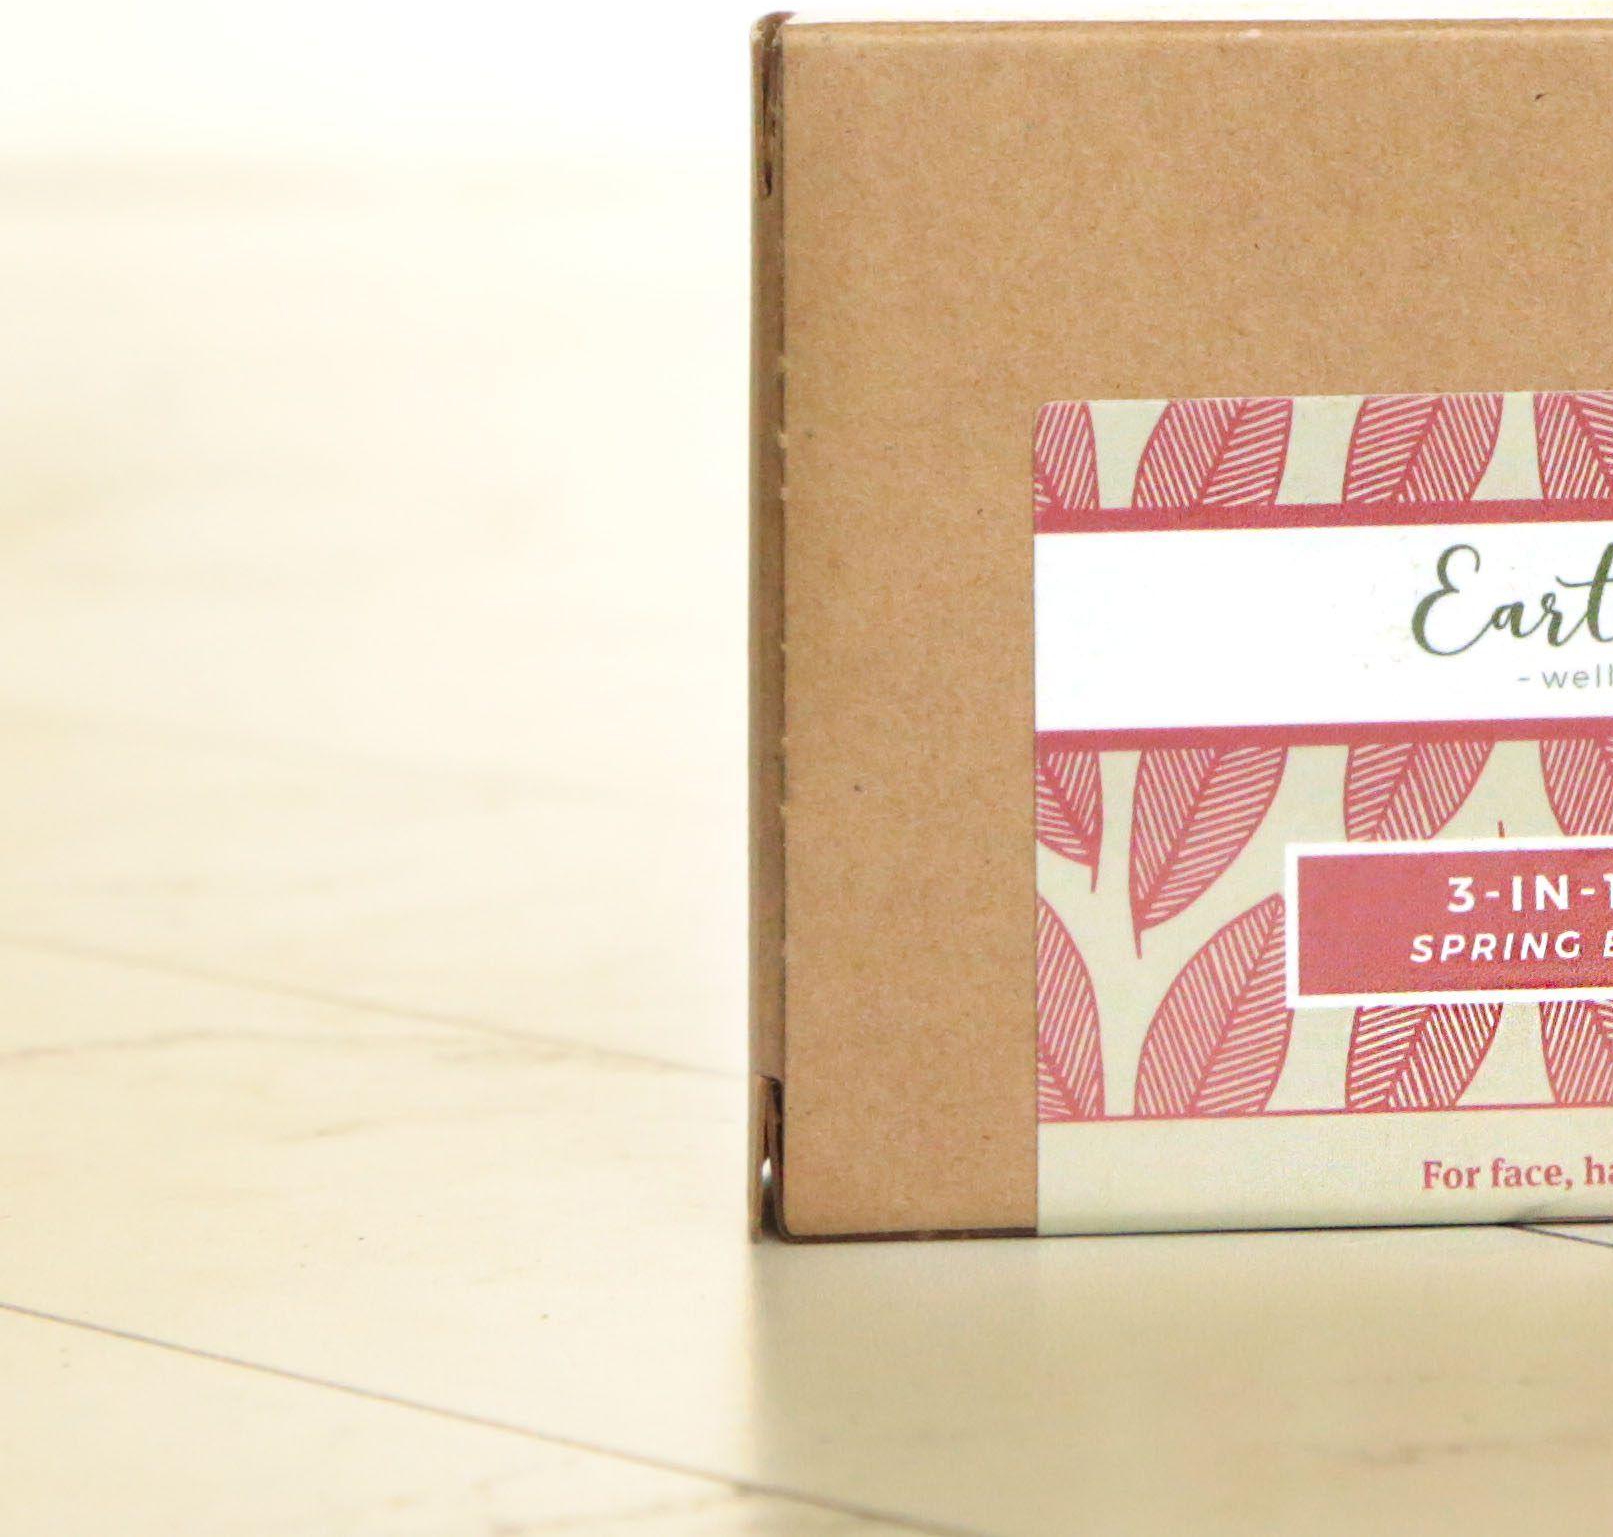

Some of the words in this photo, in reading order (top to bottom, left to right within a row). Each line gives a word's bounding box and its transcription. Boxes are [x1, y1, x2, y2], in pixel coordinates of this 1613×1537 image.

[1408, 930, 1583, 964] SPRING
[1422, 1159, 1481, 1191] For
[1491, 1156, 1574, 1192] face,
